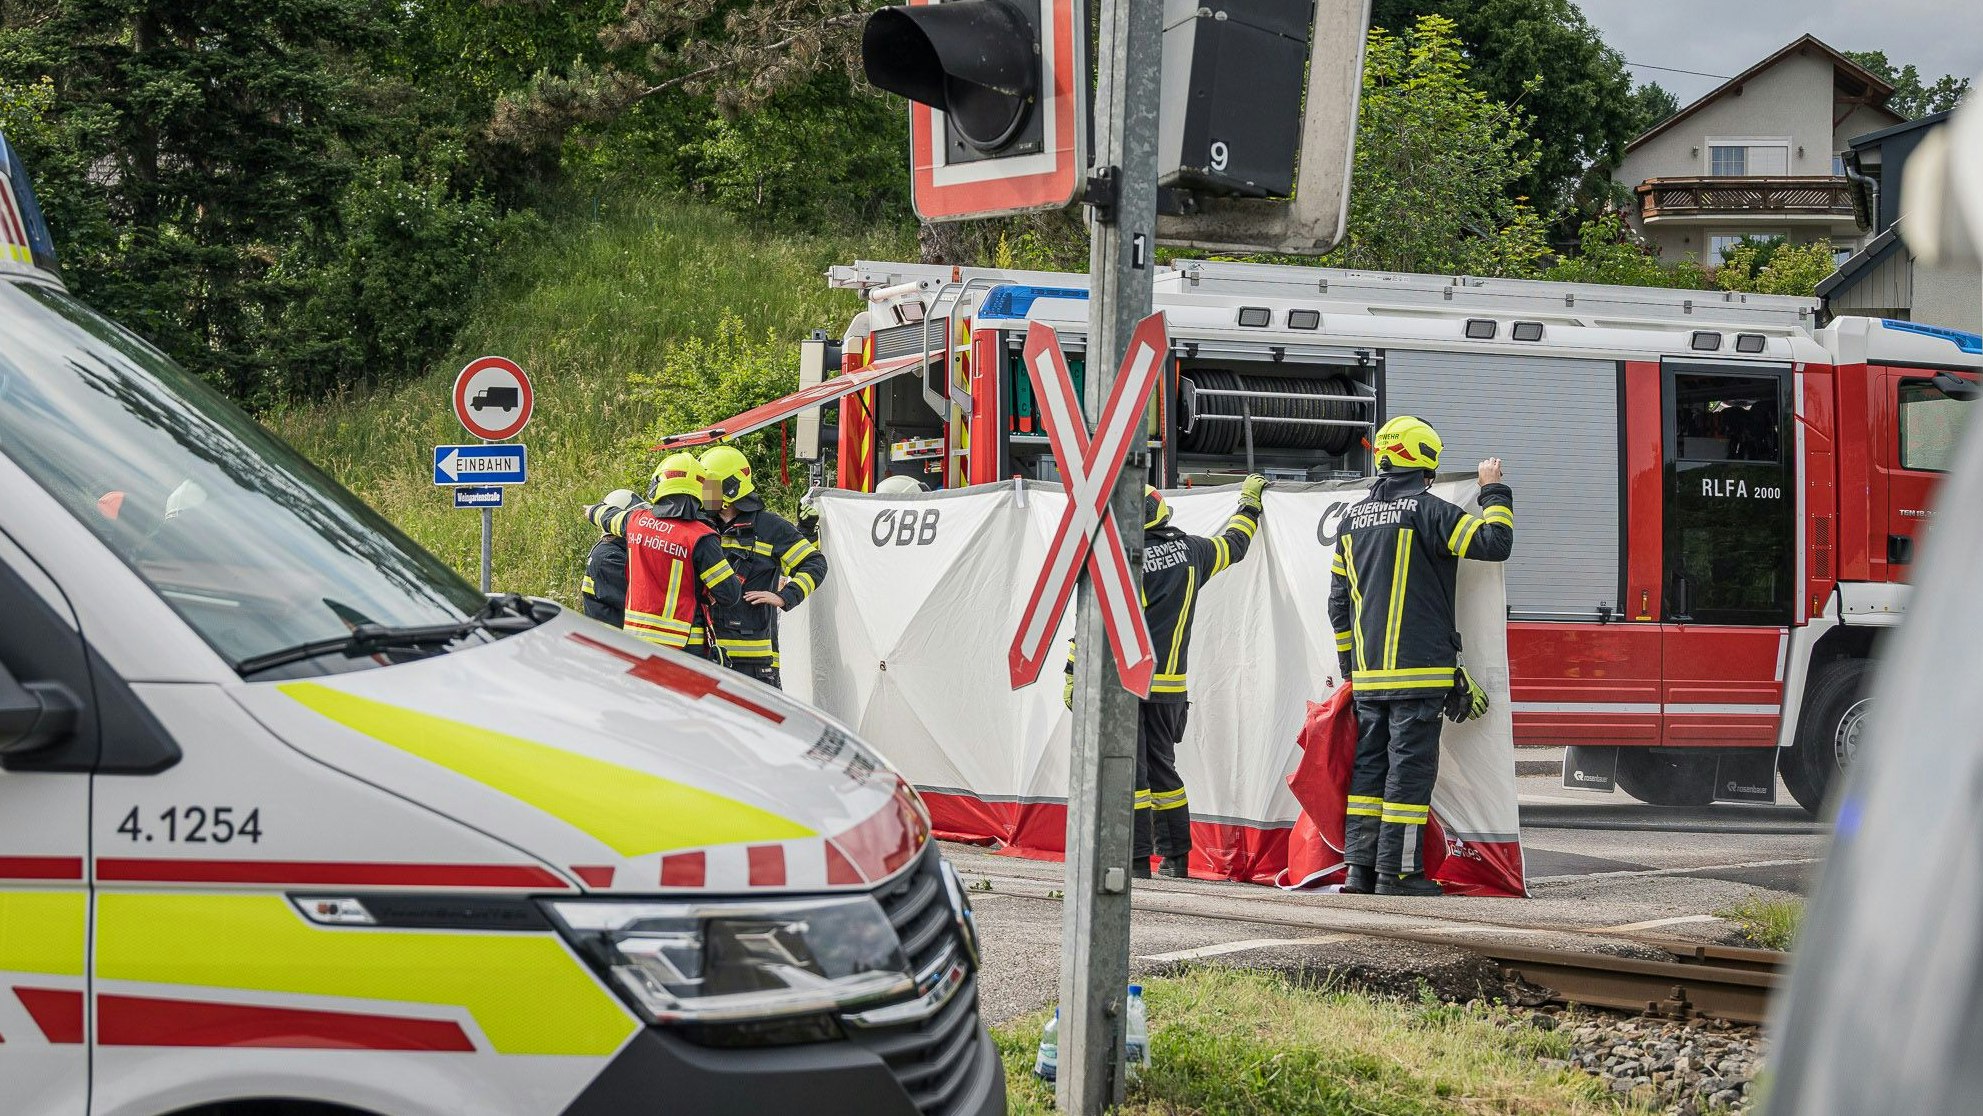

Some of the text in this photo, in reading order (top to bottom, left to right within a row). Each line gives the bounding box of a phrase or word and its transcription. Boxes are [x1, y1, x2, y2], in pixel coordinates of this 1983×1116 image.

[1211, 141, 1229, 171] 9
[1133, 235, 1145, 265] 1
[456, 458, 511, 471] EINBAHN
[1702, 478, 1781, 499] RLFA 2000
[638, 516, 675, 535] GRKDT
[871, 508, 940, 547] ÖBB
[643, 535, 688, 559] HÖFLEIN
[116, 804, 263, 844] 4.1254
